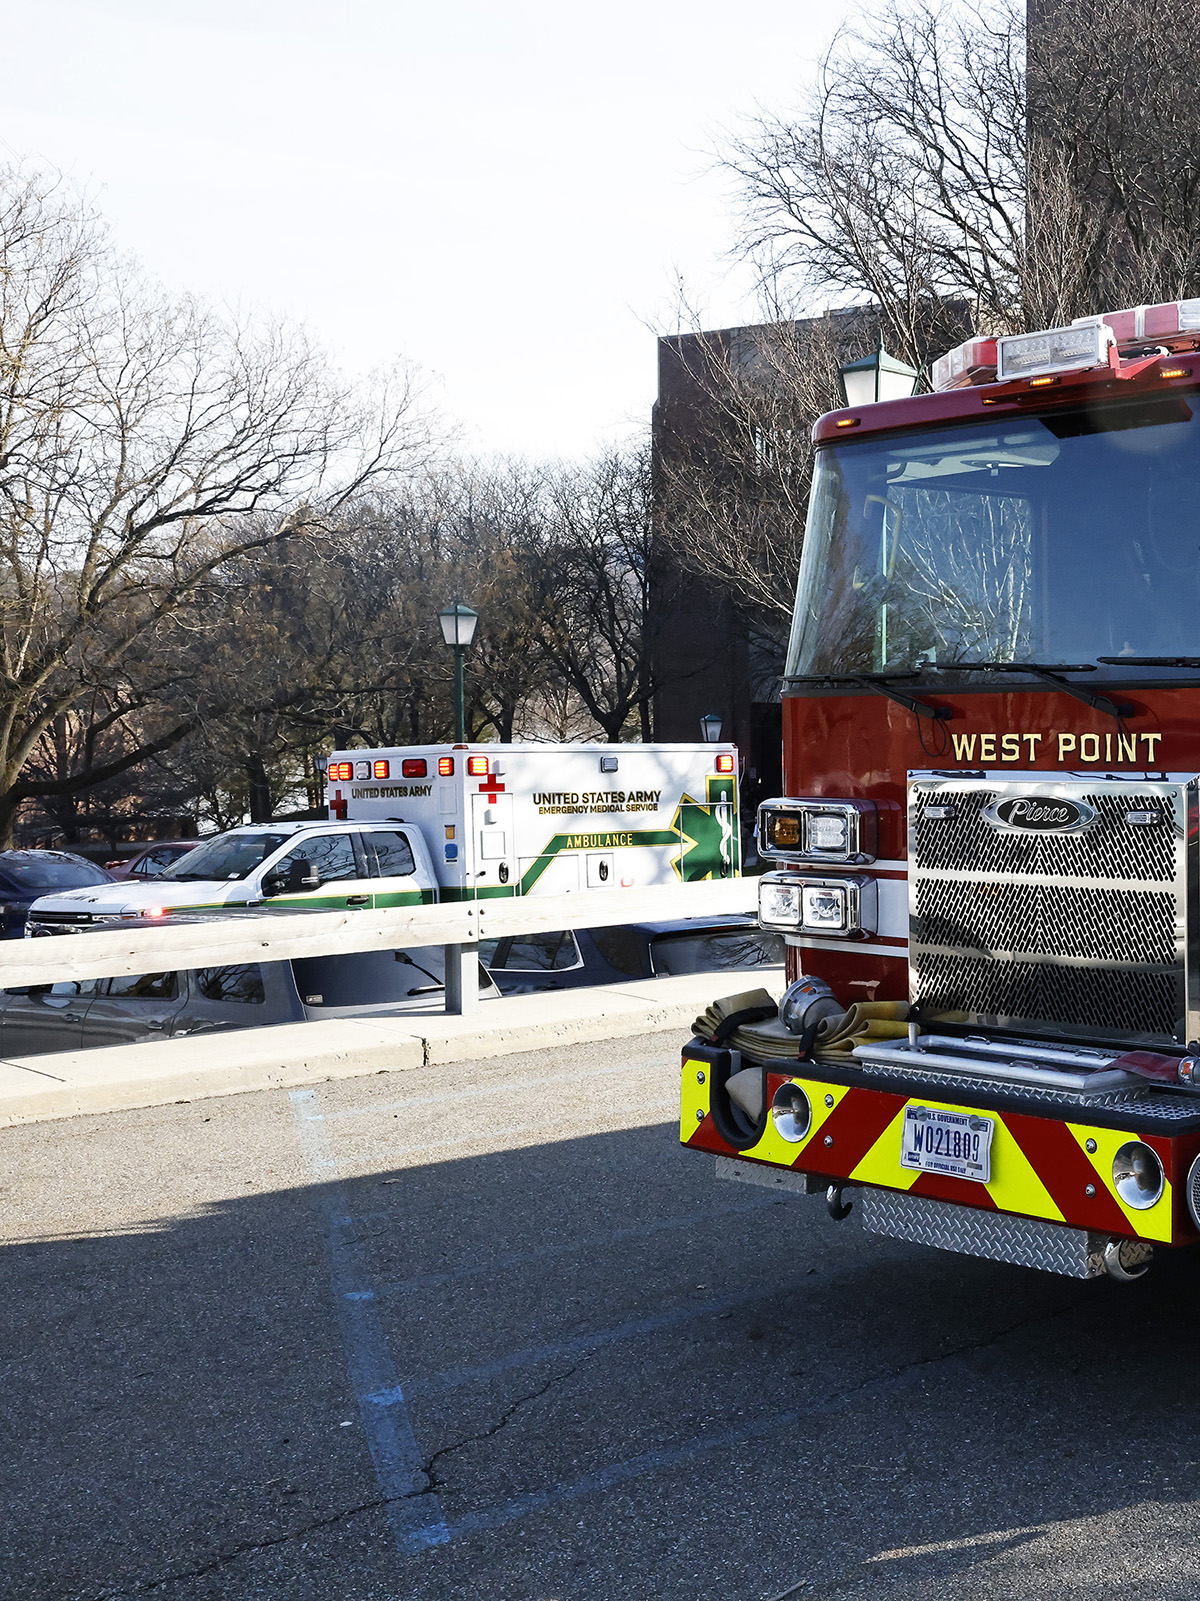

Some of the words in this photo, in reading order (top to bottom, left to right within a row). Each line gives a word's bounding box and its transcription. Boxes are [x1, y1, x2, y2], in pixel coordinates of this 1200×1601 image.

[951, 733, 1042, 762] WEST
[1057, 733, 1162, 763] POINT
[352, 787, 379, 799] UNITED
[380, 786, 408, 798] STATES
[409, 785, 432, 797] ARMY
[533, 792, 579, 805] UNITED
[581, 791, 625, 803] STATES
[627, 790, 662, 802] ARMY
[539, 805, 588, 814] EMERGENCY
[590, 804, 624, 813] MEDICAL
[625, 803, 658, 812] SERVICE
[1008, 799, 1069, 825] Pierce
[566, 834, 633, 848] AMBULANCE
[937, 1114, 968, 1125] GOVERNMENT
[914, 1123, 980, 1162] W021809
